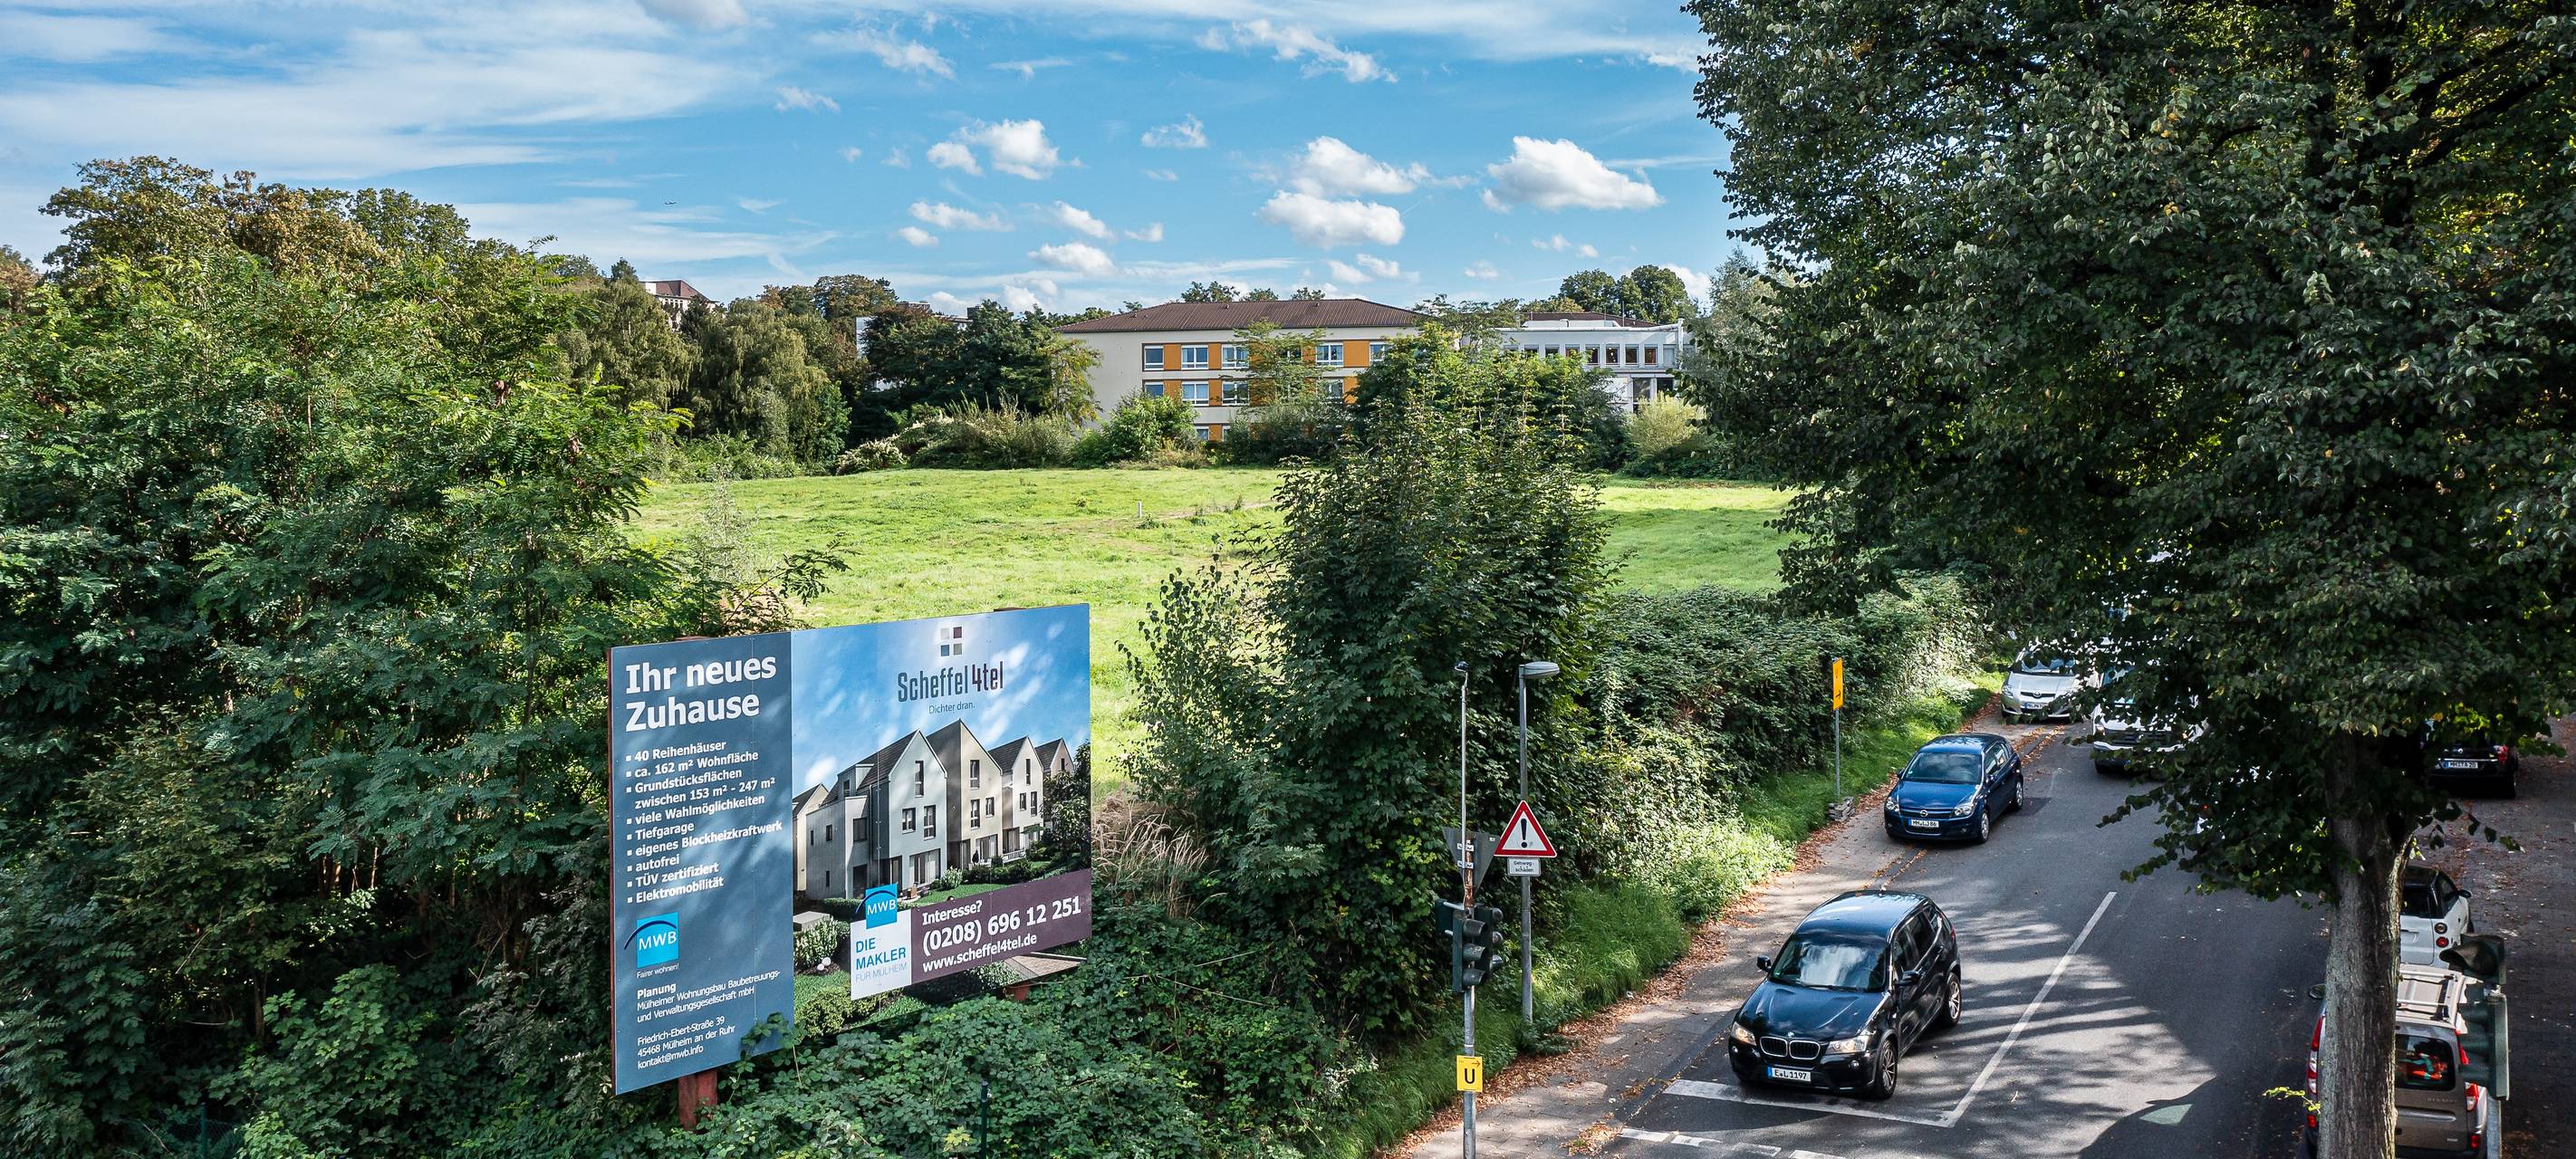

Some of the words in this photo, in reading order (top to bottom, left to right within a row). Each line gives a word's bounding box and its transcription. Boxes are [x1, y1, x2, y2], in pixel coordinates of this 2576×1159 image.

[626, 662, 678, 694] Ihr
[687, 656, 776, 687] neues
[625, 694, 760, 733] Zuhause
[928, 701, 956, 714] Dichter
[956, 700, 976, 711] dran.
[634, 751, 649, 762] 40
[652, 741, 726, 760] Reihenhäuser
[634, 769, 651, 778] ca.
[654, 762, 675, 775] 162
[678, 759, 694, 771] m²
[697, 751, 759, 769] Wohnfläche
[634, 769, 743, 793] Grundstücksflächen
[634, 792, 686, 809] zwischen
[689, 788, 710, 800] 153
[712, 785, 727, 797] m²
[738, 780, 758, 792] 247
[761, 777, 775, 789] m²
[635, 809, 662, 825] viele
[665, 795, 765, 820] Wahlmöglichkeiten
[635, 821, 695, 841] Tiefgarage
[635, 840, 678, 857] eigenes
[681, 820, 783, 848] Blockheizkraftwerk
[635, 854, 680, 872] autofrei
[635, 873, 659, 887] TÜV
[661, 862, 720, 883] zertifiziert
[636, 876, 725, 904] Elektromobilität
[867, 899, 896, 915] MWB
[922, 900, 983, 925] Interesse?
[923, 919, 982, 957] (0208)
[987, 910, 1021, 936] 696
[1026, 904, 1047, 926] 12
[1052, 896, 1081, 920] 251
[639, 931, 677, 951] MWB
[856, 937, 876, 953] DIE
[922, 933, 1037, 972] www.scheffel4tel.de
[636, 969, 653, 979] Fairer
[654, 963, 679, 975] wohnen!
[856, 947, 907, 970] MAKLER
[855, 968, 871, 982] FÜR
[872, 963, 908, 979] MÜLHEIM
[637, 995, 675, 1011] Mülheimer
[677, 982, 726, 1001] Wohnungsbau
[727, 970, 781, 989] Baubetreuungs-
[637, 983, 677, 1000] Planung
[637, 1011, 652, 1023] und
[653, 991, 737, 1019] Verwaltungsgesellschaft
[738, 986, 755, 998] mbH
[637, 1019, 714, 1046] Friedrich-Ebert-Straße
[716, 1015, 725, 1026] 39
[637, 1043, 660, 1058] 45468
[662, 1037, 693, 1051] Mülheim
[694, 1034, 704, 1043] an
[705, 1030, 717, 1039] der
[718, 1025, 735, 1037] Ruhr
[638, 1044, 704, 1069] kontakt@mwb.info
[1464, 1068, 1475, 1084] U
